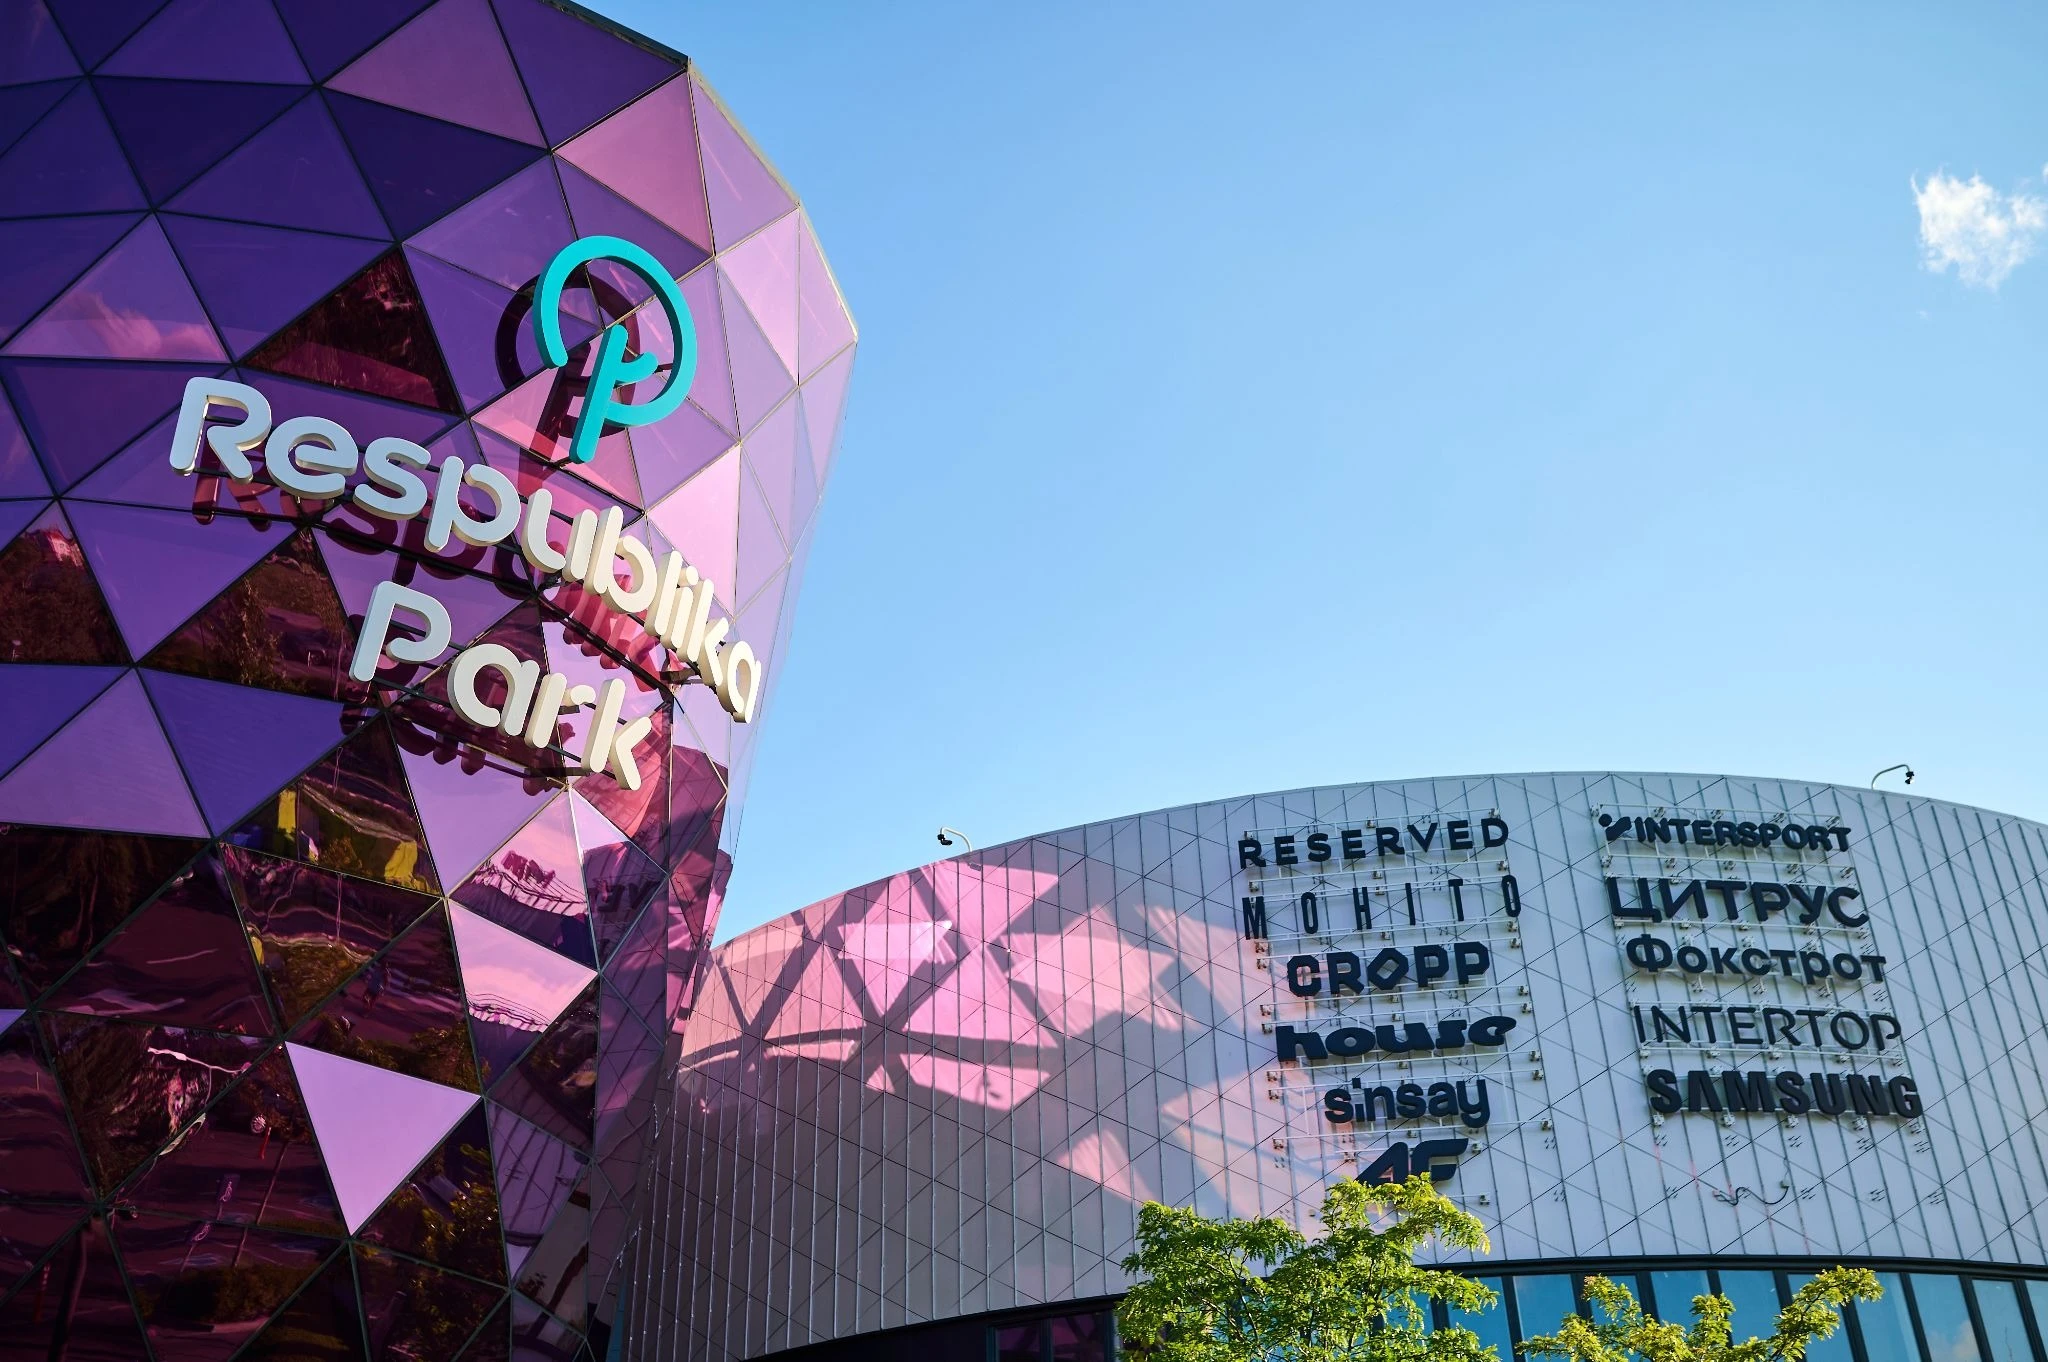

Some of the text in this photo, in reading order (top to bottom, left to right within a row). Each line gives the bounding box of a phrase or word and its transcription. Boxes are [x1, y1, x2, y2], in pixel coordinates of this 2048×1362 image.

[169, 376, 761, 723] Respublika
[348, 581, 652, 790] Park
[1238, 817, 1509, 869] RESERVED
[1634, 816, 1852, 852] INTERSPORT
[1242, 874, 1521, 940] MOHITO
[1606, 876, 1869, 928] ЦИТРУС
[1286, 941, 1490, 997] CROPP
[1626, 933, 1886, 985] Фокстрот
[1276, 1015, 1517, 1062] house
[1633, 1005, 1902, 1051] INTERTOP
[1324, 1077, 1490, 1129] sinsay
[1646, 1068, 1924, 1119] SAMSUNG
